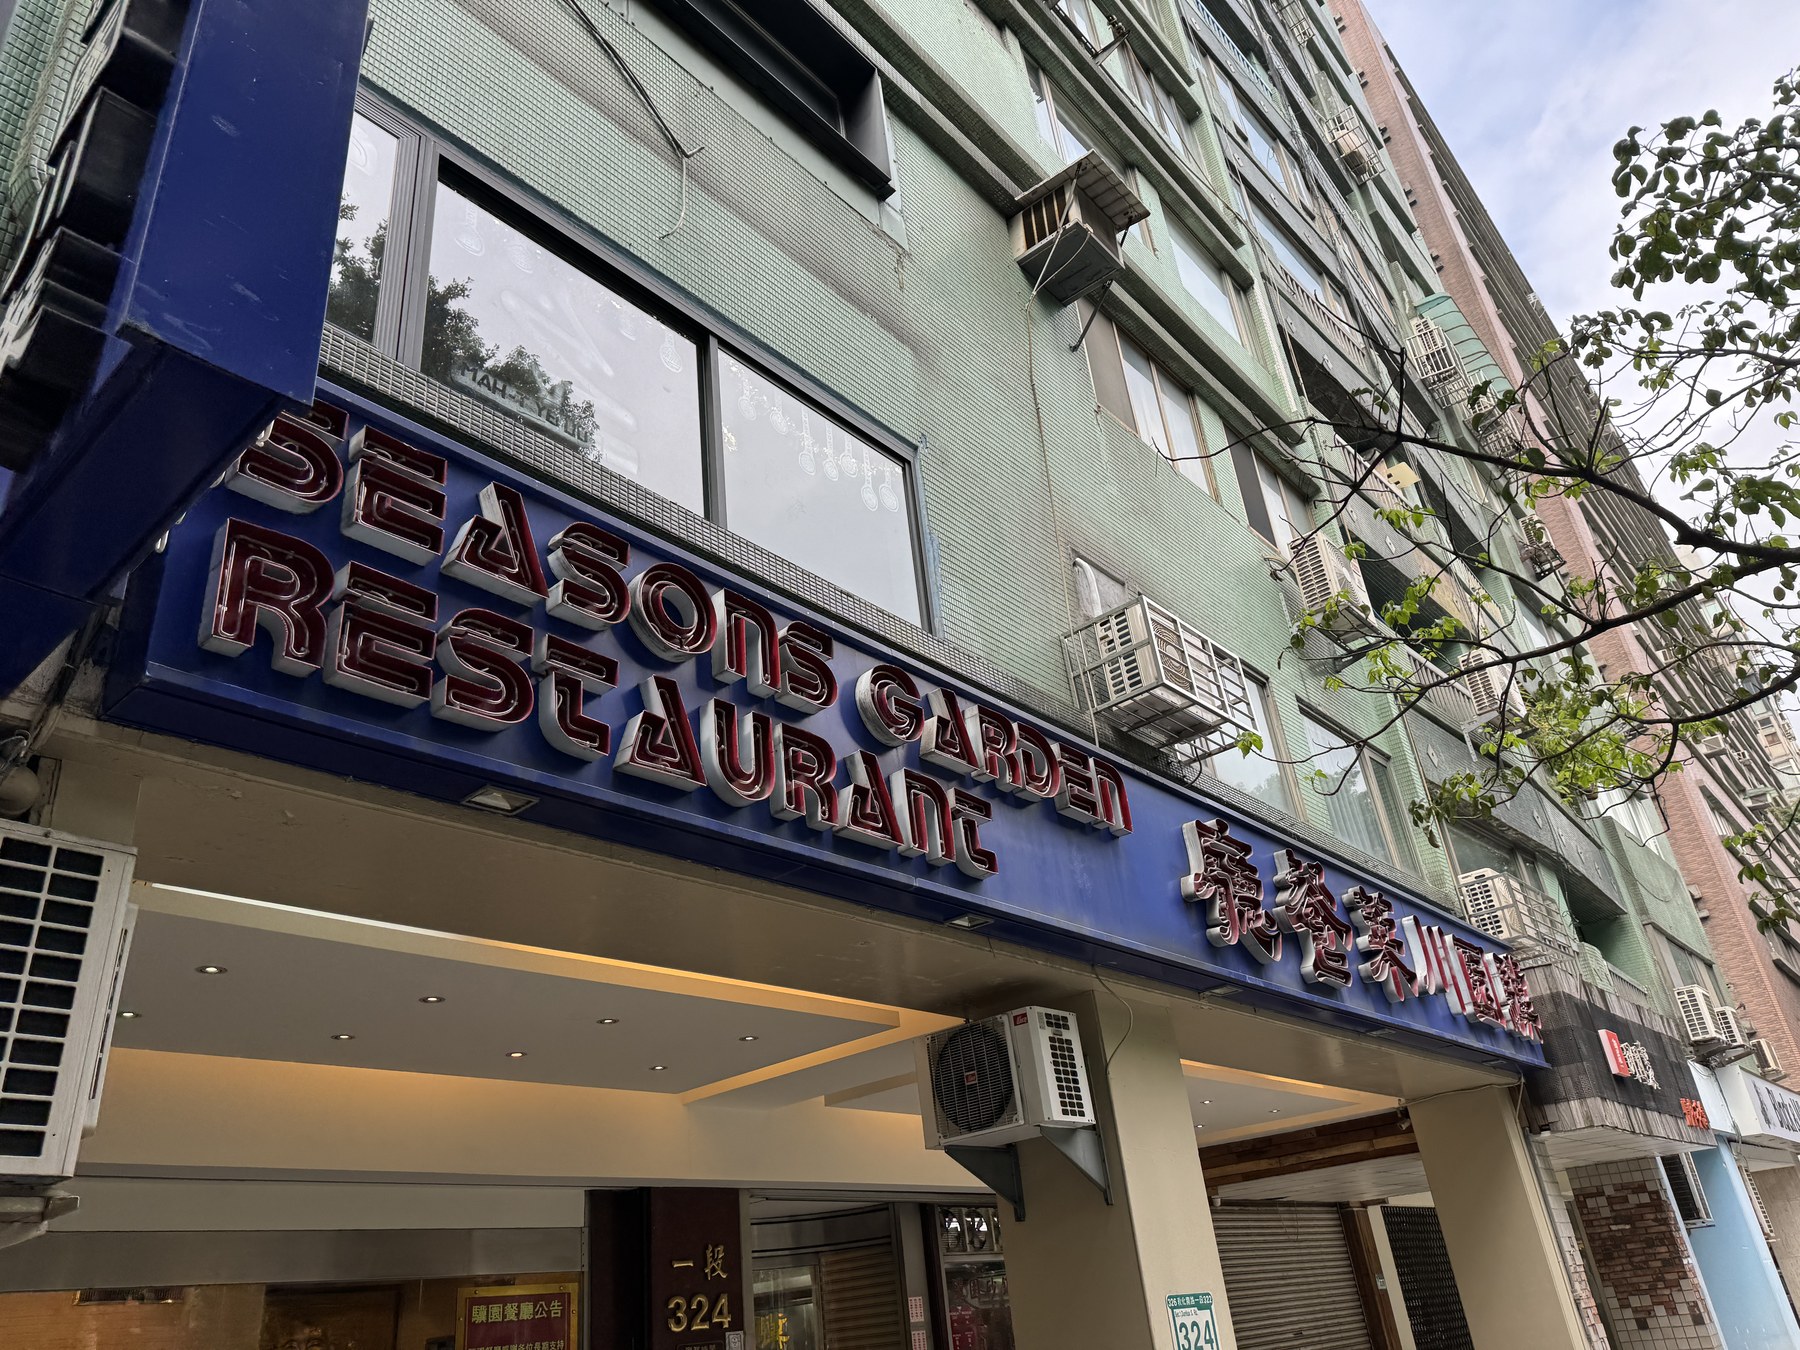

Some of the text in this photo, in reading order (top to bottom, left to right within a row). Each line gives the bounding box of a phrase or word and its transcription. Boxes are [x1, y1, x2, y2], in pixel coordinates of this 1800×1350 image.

[224, 398, 1134, 838] SEASONS GARDEN
[198, 517, 999, 880] RESTAURANT
[671, 1244, 729, 1281] 一段
[471, 1300, 563, 1324] 驥園餐廳公告
[667, 1293, 732, 1332] 324
[1179, 1320, 1215, 1350] 324
